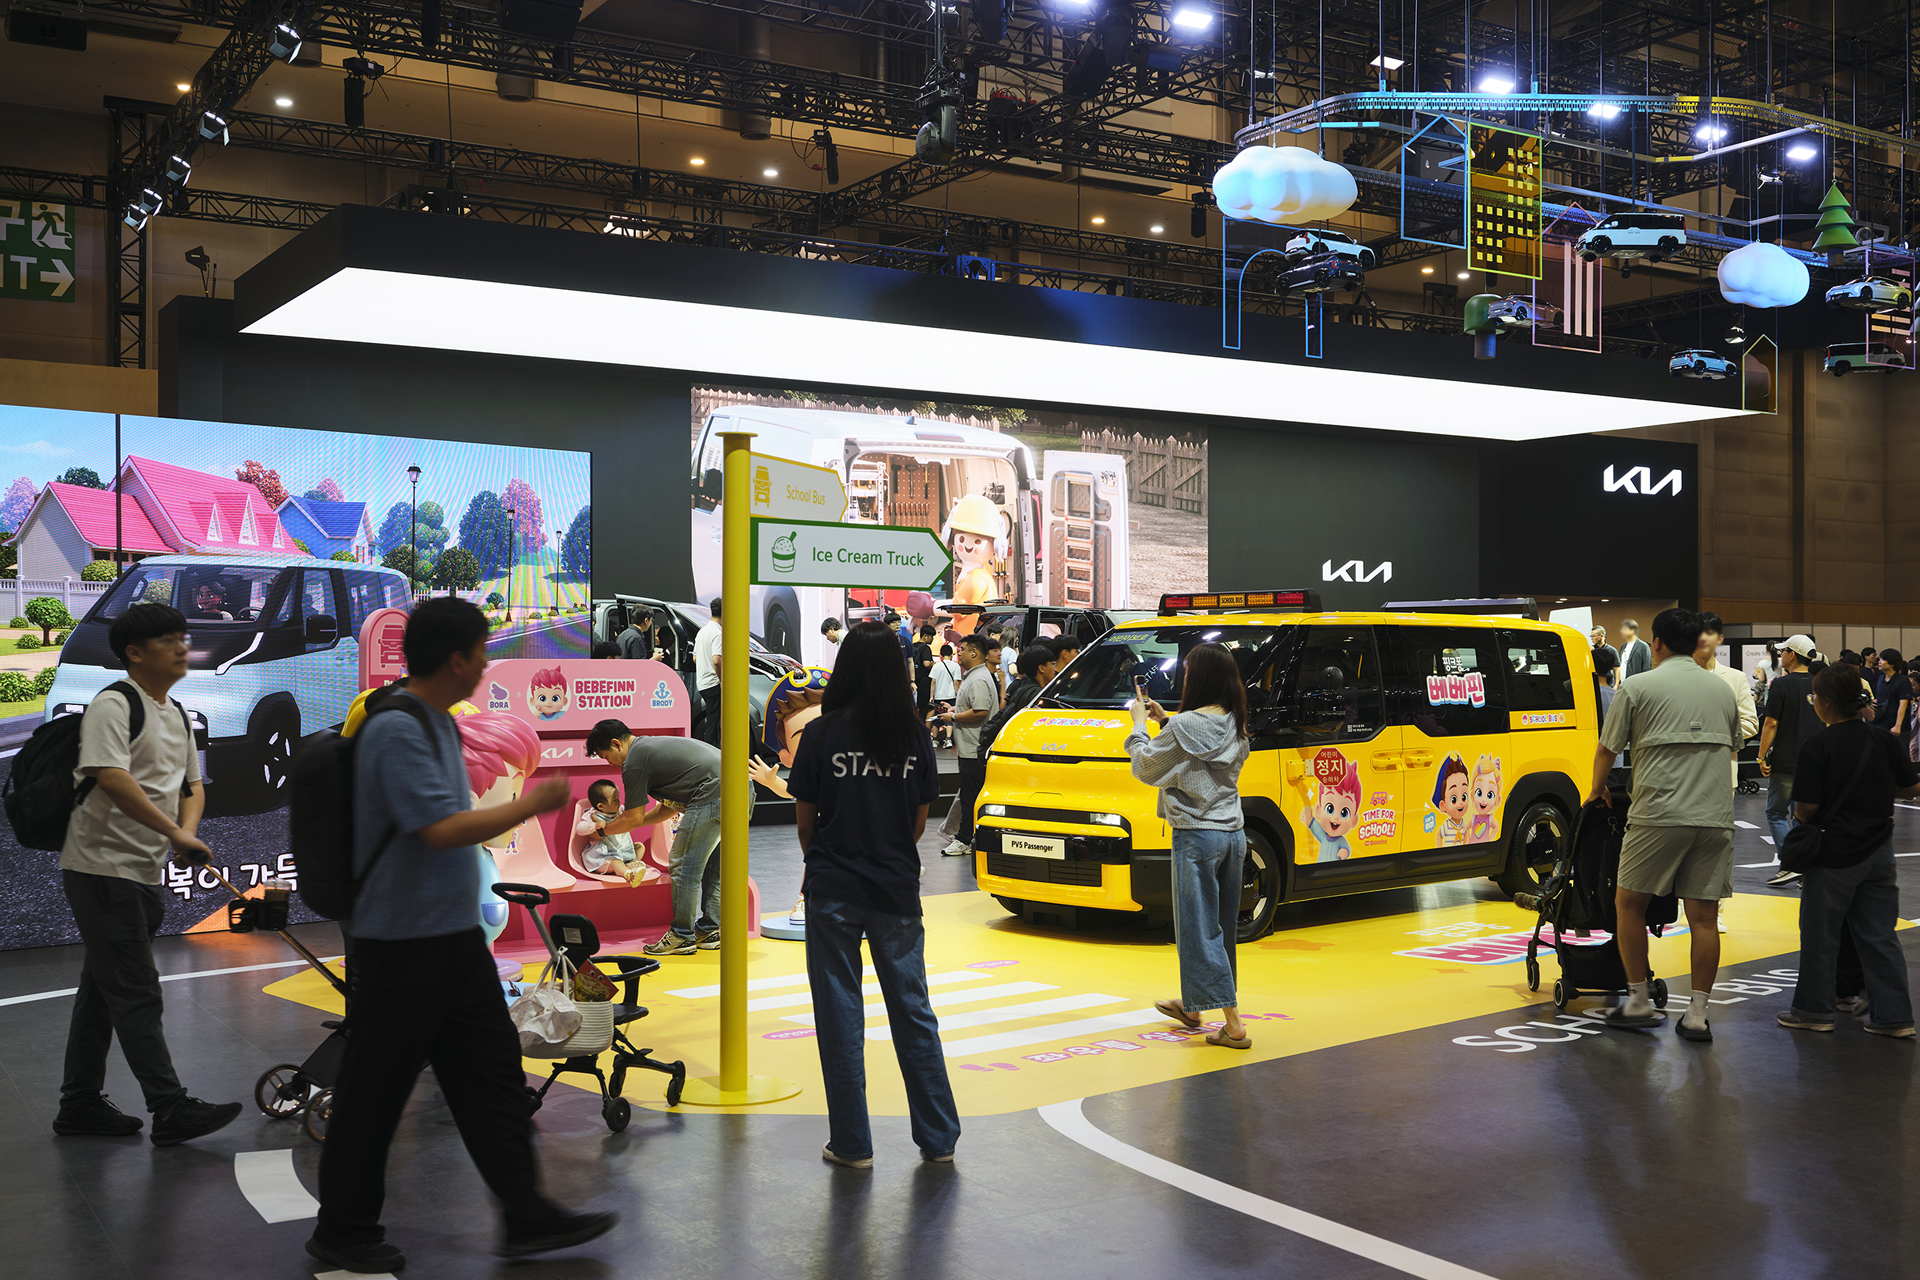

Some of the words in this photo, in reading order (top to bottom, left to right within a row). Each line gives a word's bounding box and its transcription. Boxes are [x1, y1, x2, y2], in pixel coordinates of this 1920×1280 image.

[1603, 464, 1682, 497] KIA
[786, 485, 811, 503] School
[813, 489, 826, 506] Bus
[812, 547, 833, 562] Ice
[837, 548, 882, 564] Cream
[887, 550, 925, 567] Truck
[1322, 559, 1393, 584] KIA
[1221, 597, 1235, 605] SCHOOL
[1442, 656, 1466, 673] 핑크퐁
[575, 680, 635, 694] BEBEFINN
[1427, 672, 1485, 706] 베베핀
[489, 701, 509, 709] BORA
[578, 694, 631, 708] STATION
[652, 699, 673, 708] BRODY
[1046, 717, 1085, 727] SCHOOL
[1082, 718, 1107, 728] BUS
[1529, 714, 1548, 724] SCHOOL
[1548, 713, 1558, 723] BUS
[1041, 742, 1067, 752] KIA
[1316, 759, 1343, 776] 정지
[1363, 810, 1381, 822] TIME
[1381, 809, 1395, 820] FOR
[1359, 822, 1396, 840] SCHOOL!
[1011, 840, 1023, 849] PV5
[1023, 842, 1054, 853] Passenger
[161, 860, 230, 900] 복이
